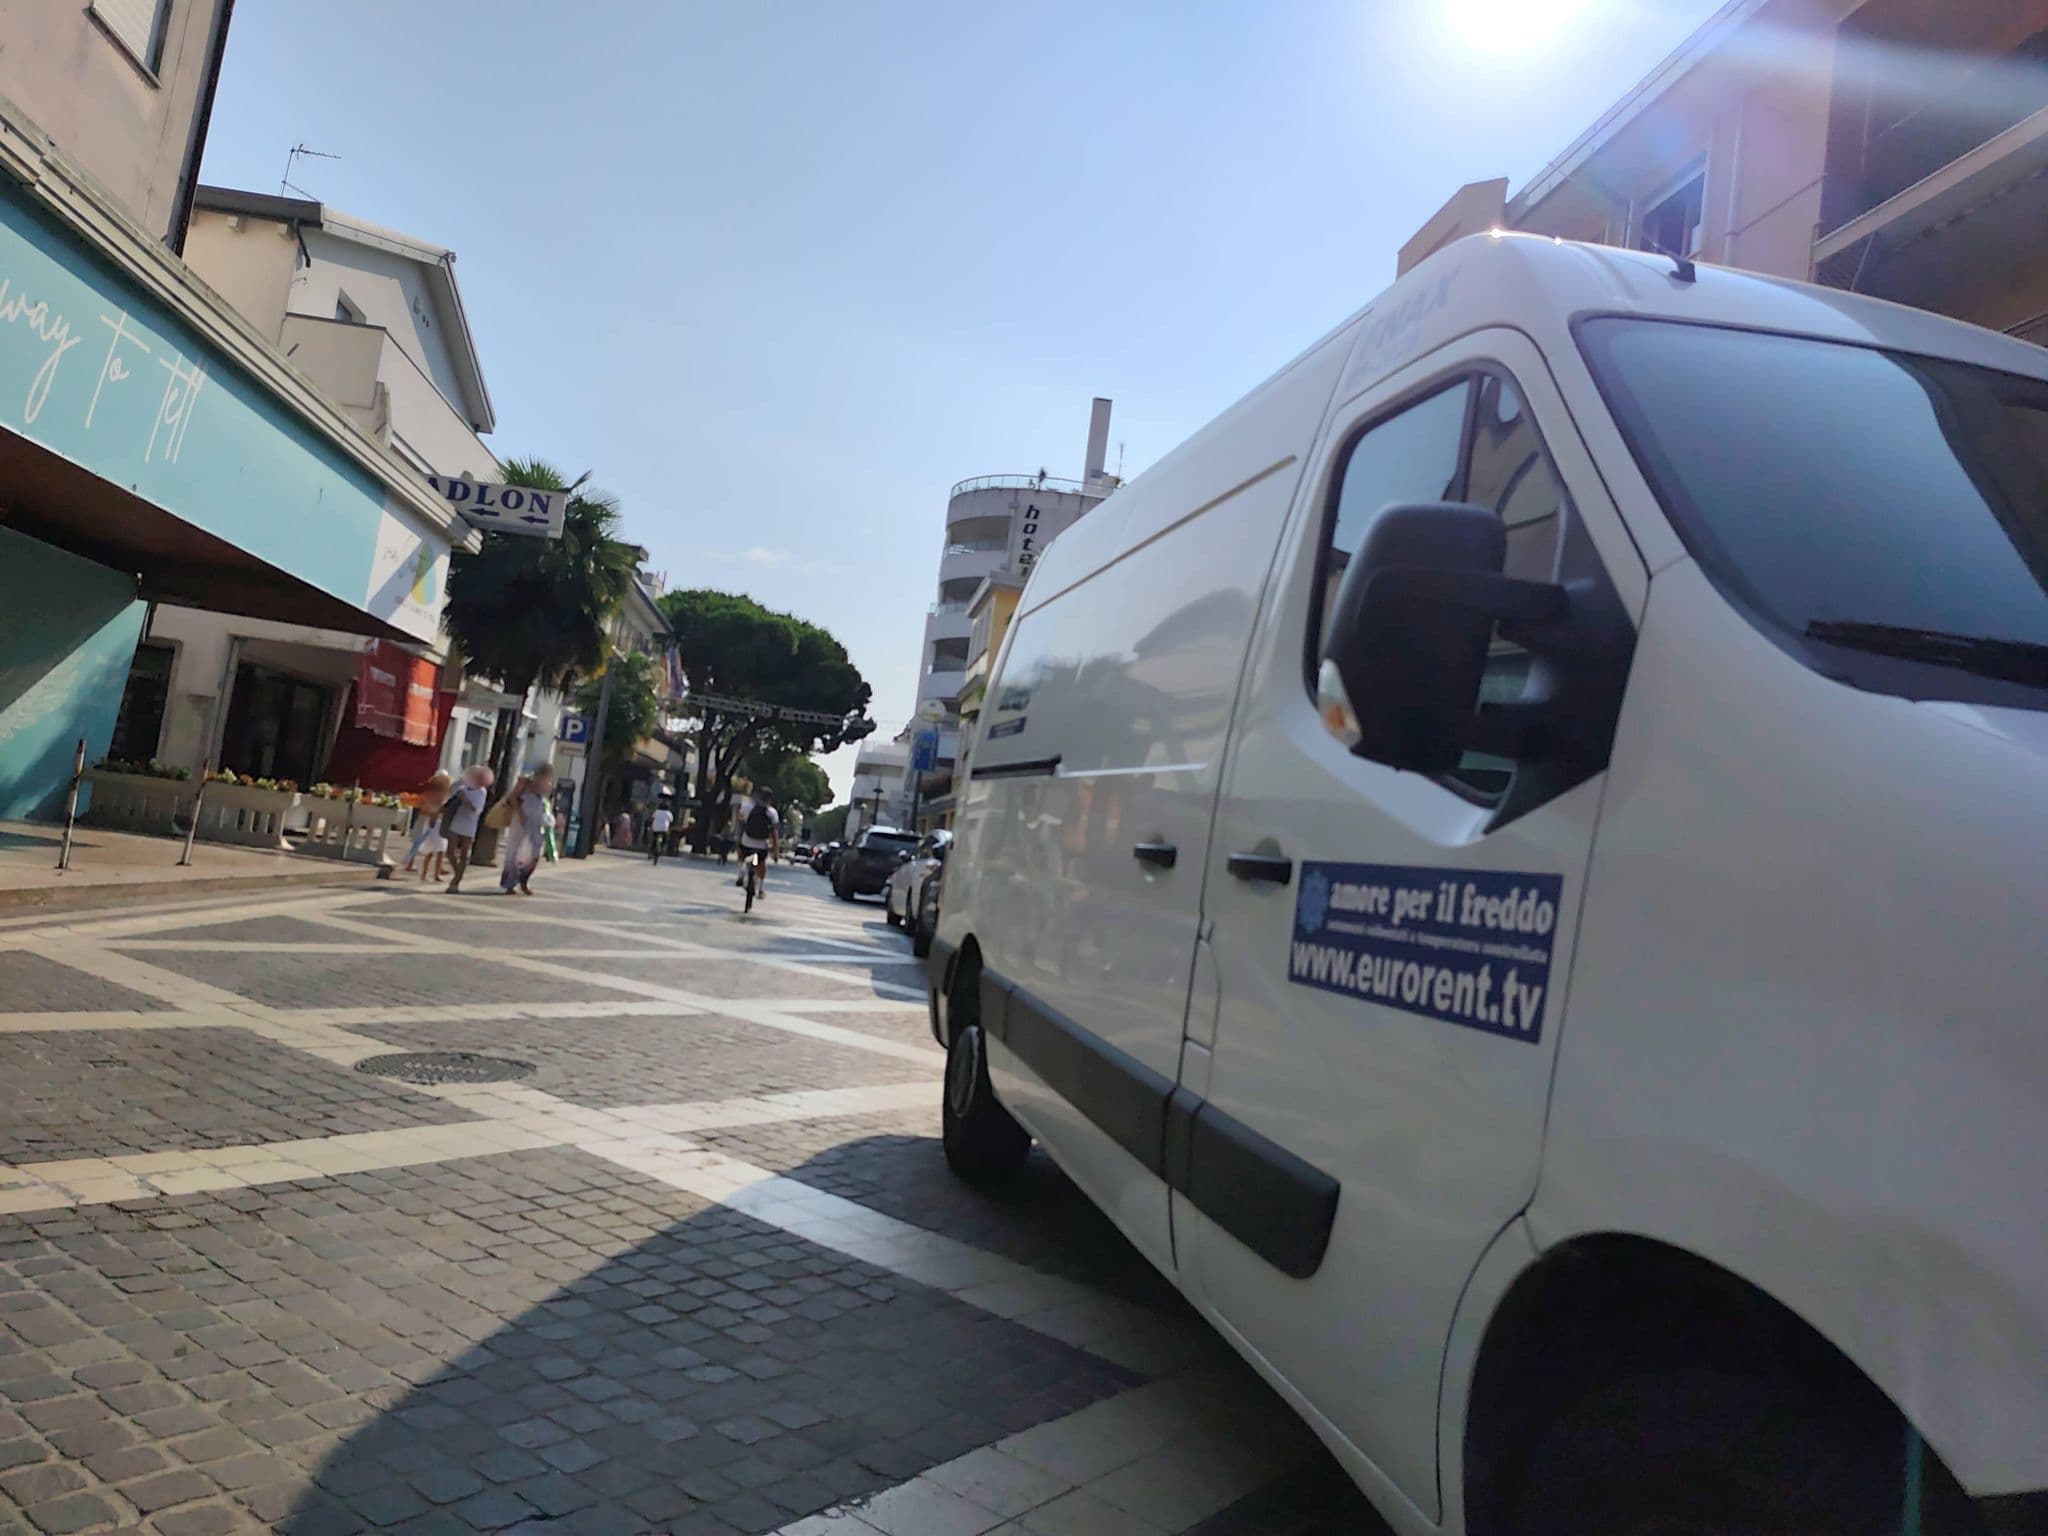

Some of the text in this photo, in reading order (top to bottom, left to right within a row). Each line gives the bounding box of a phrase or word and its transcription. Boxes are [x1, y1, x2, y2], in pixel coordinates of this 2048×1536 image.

[565, 718, 584, 740] P
[1330, 882, 1553, 936] amore per il freddo
[1293, 942, 1542, 1031] www.eurorent.tv
